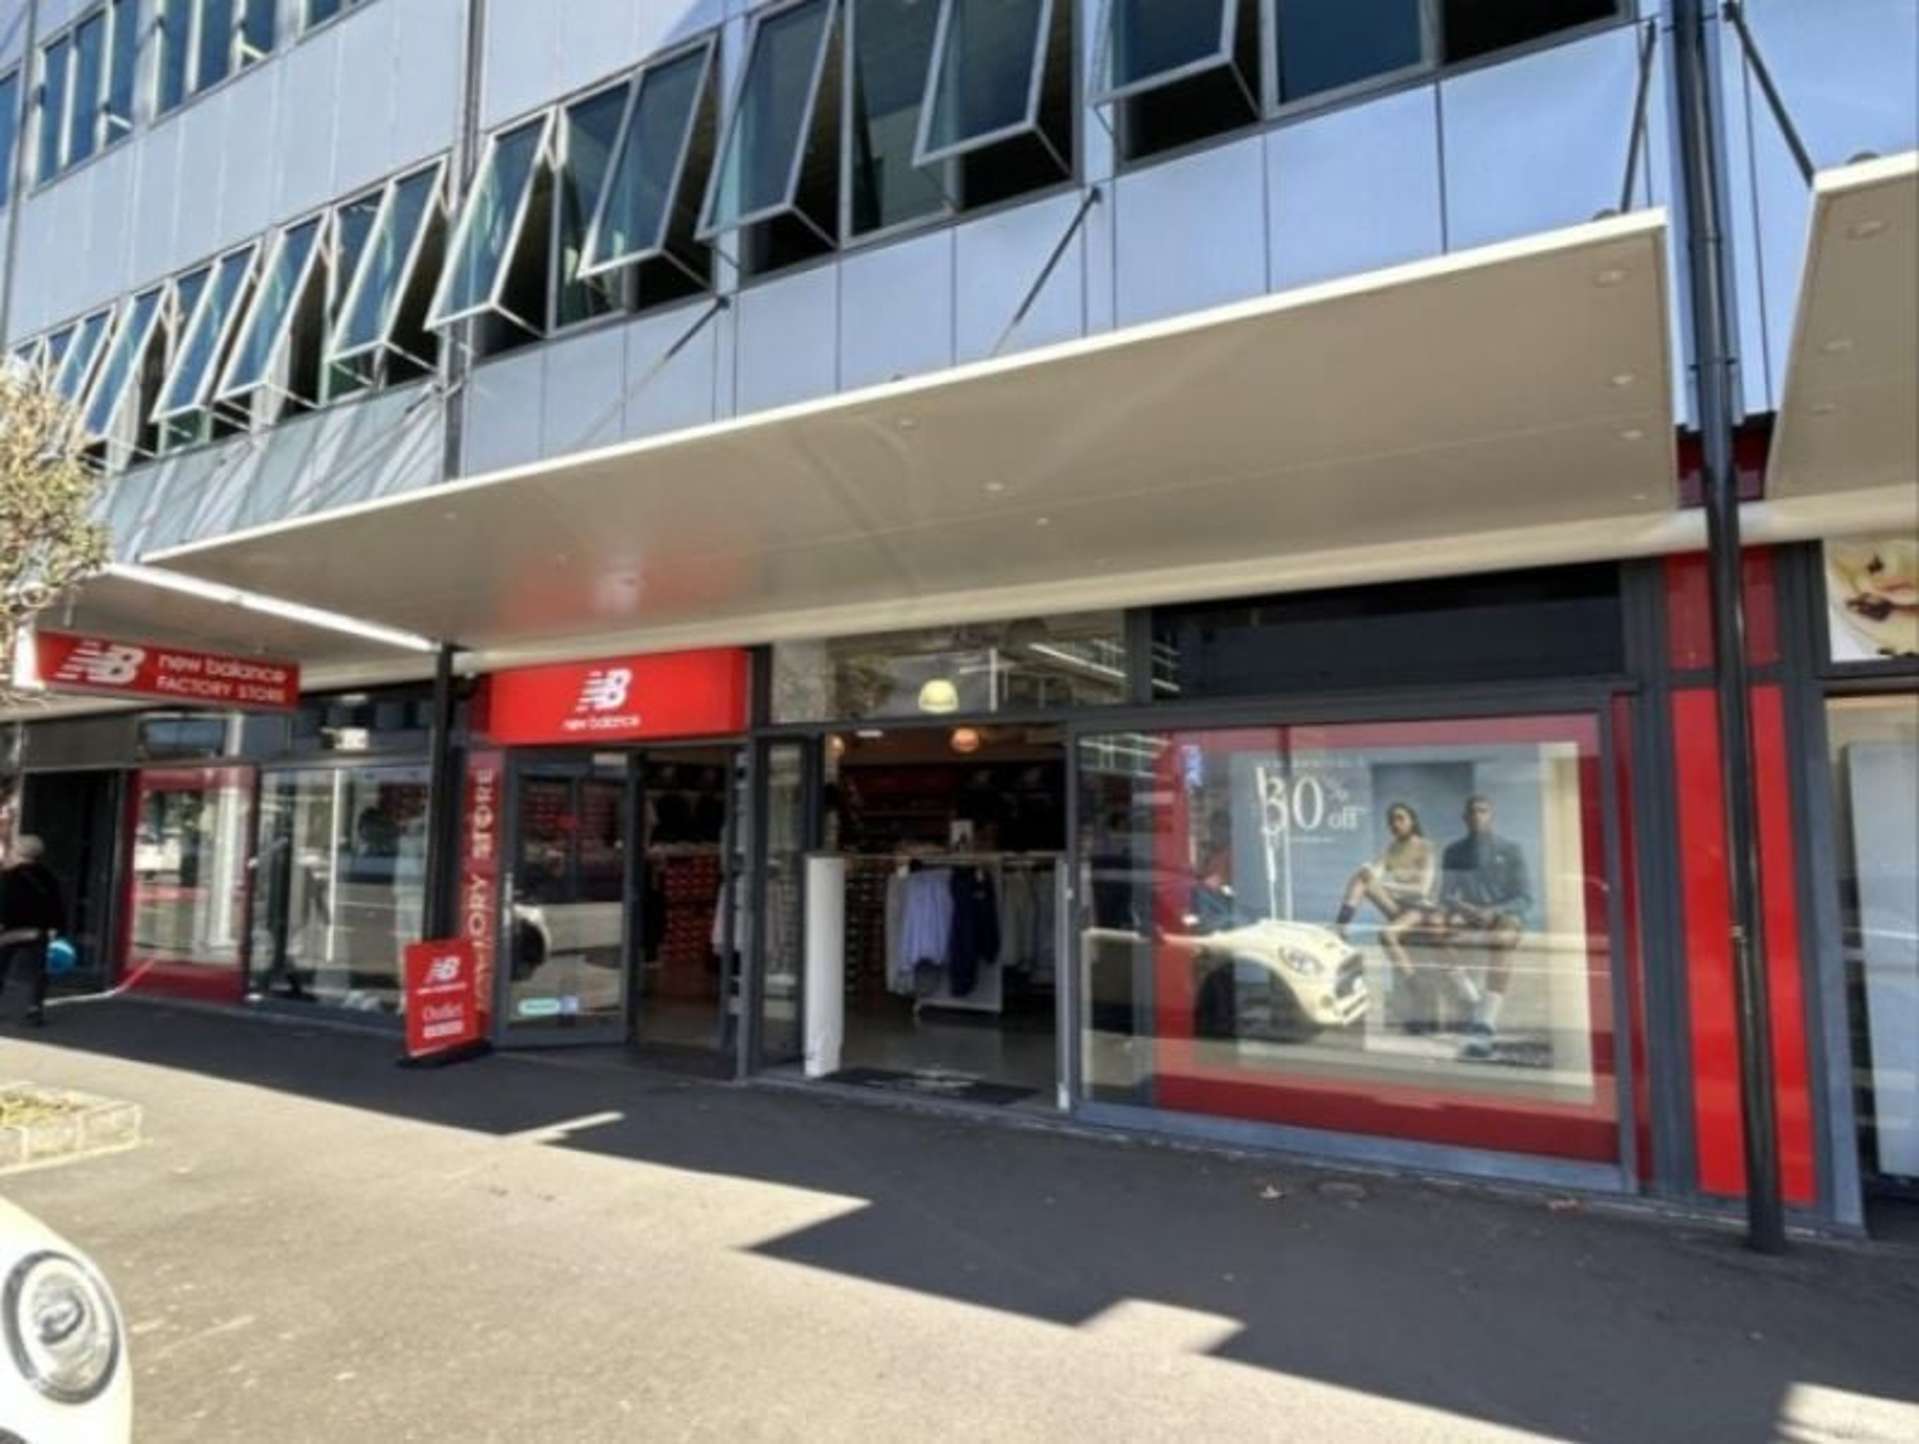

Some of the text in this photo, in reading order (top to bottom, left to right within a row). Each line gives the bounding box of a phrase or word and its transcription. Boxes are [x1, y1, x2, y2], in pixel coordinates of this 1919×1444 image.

[158, 654, 287, 683] new balance
[156, 675, 286, 701] FACTORY STORE
[472, 767, 494, 860] STORE
[1327, 805, 1369, 830] off
